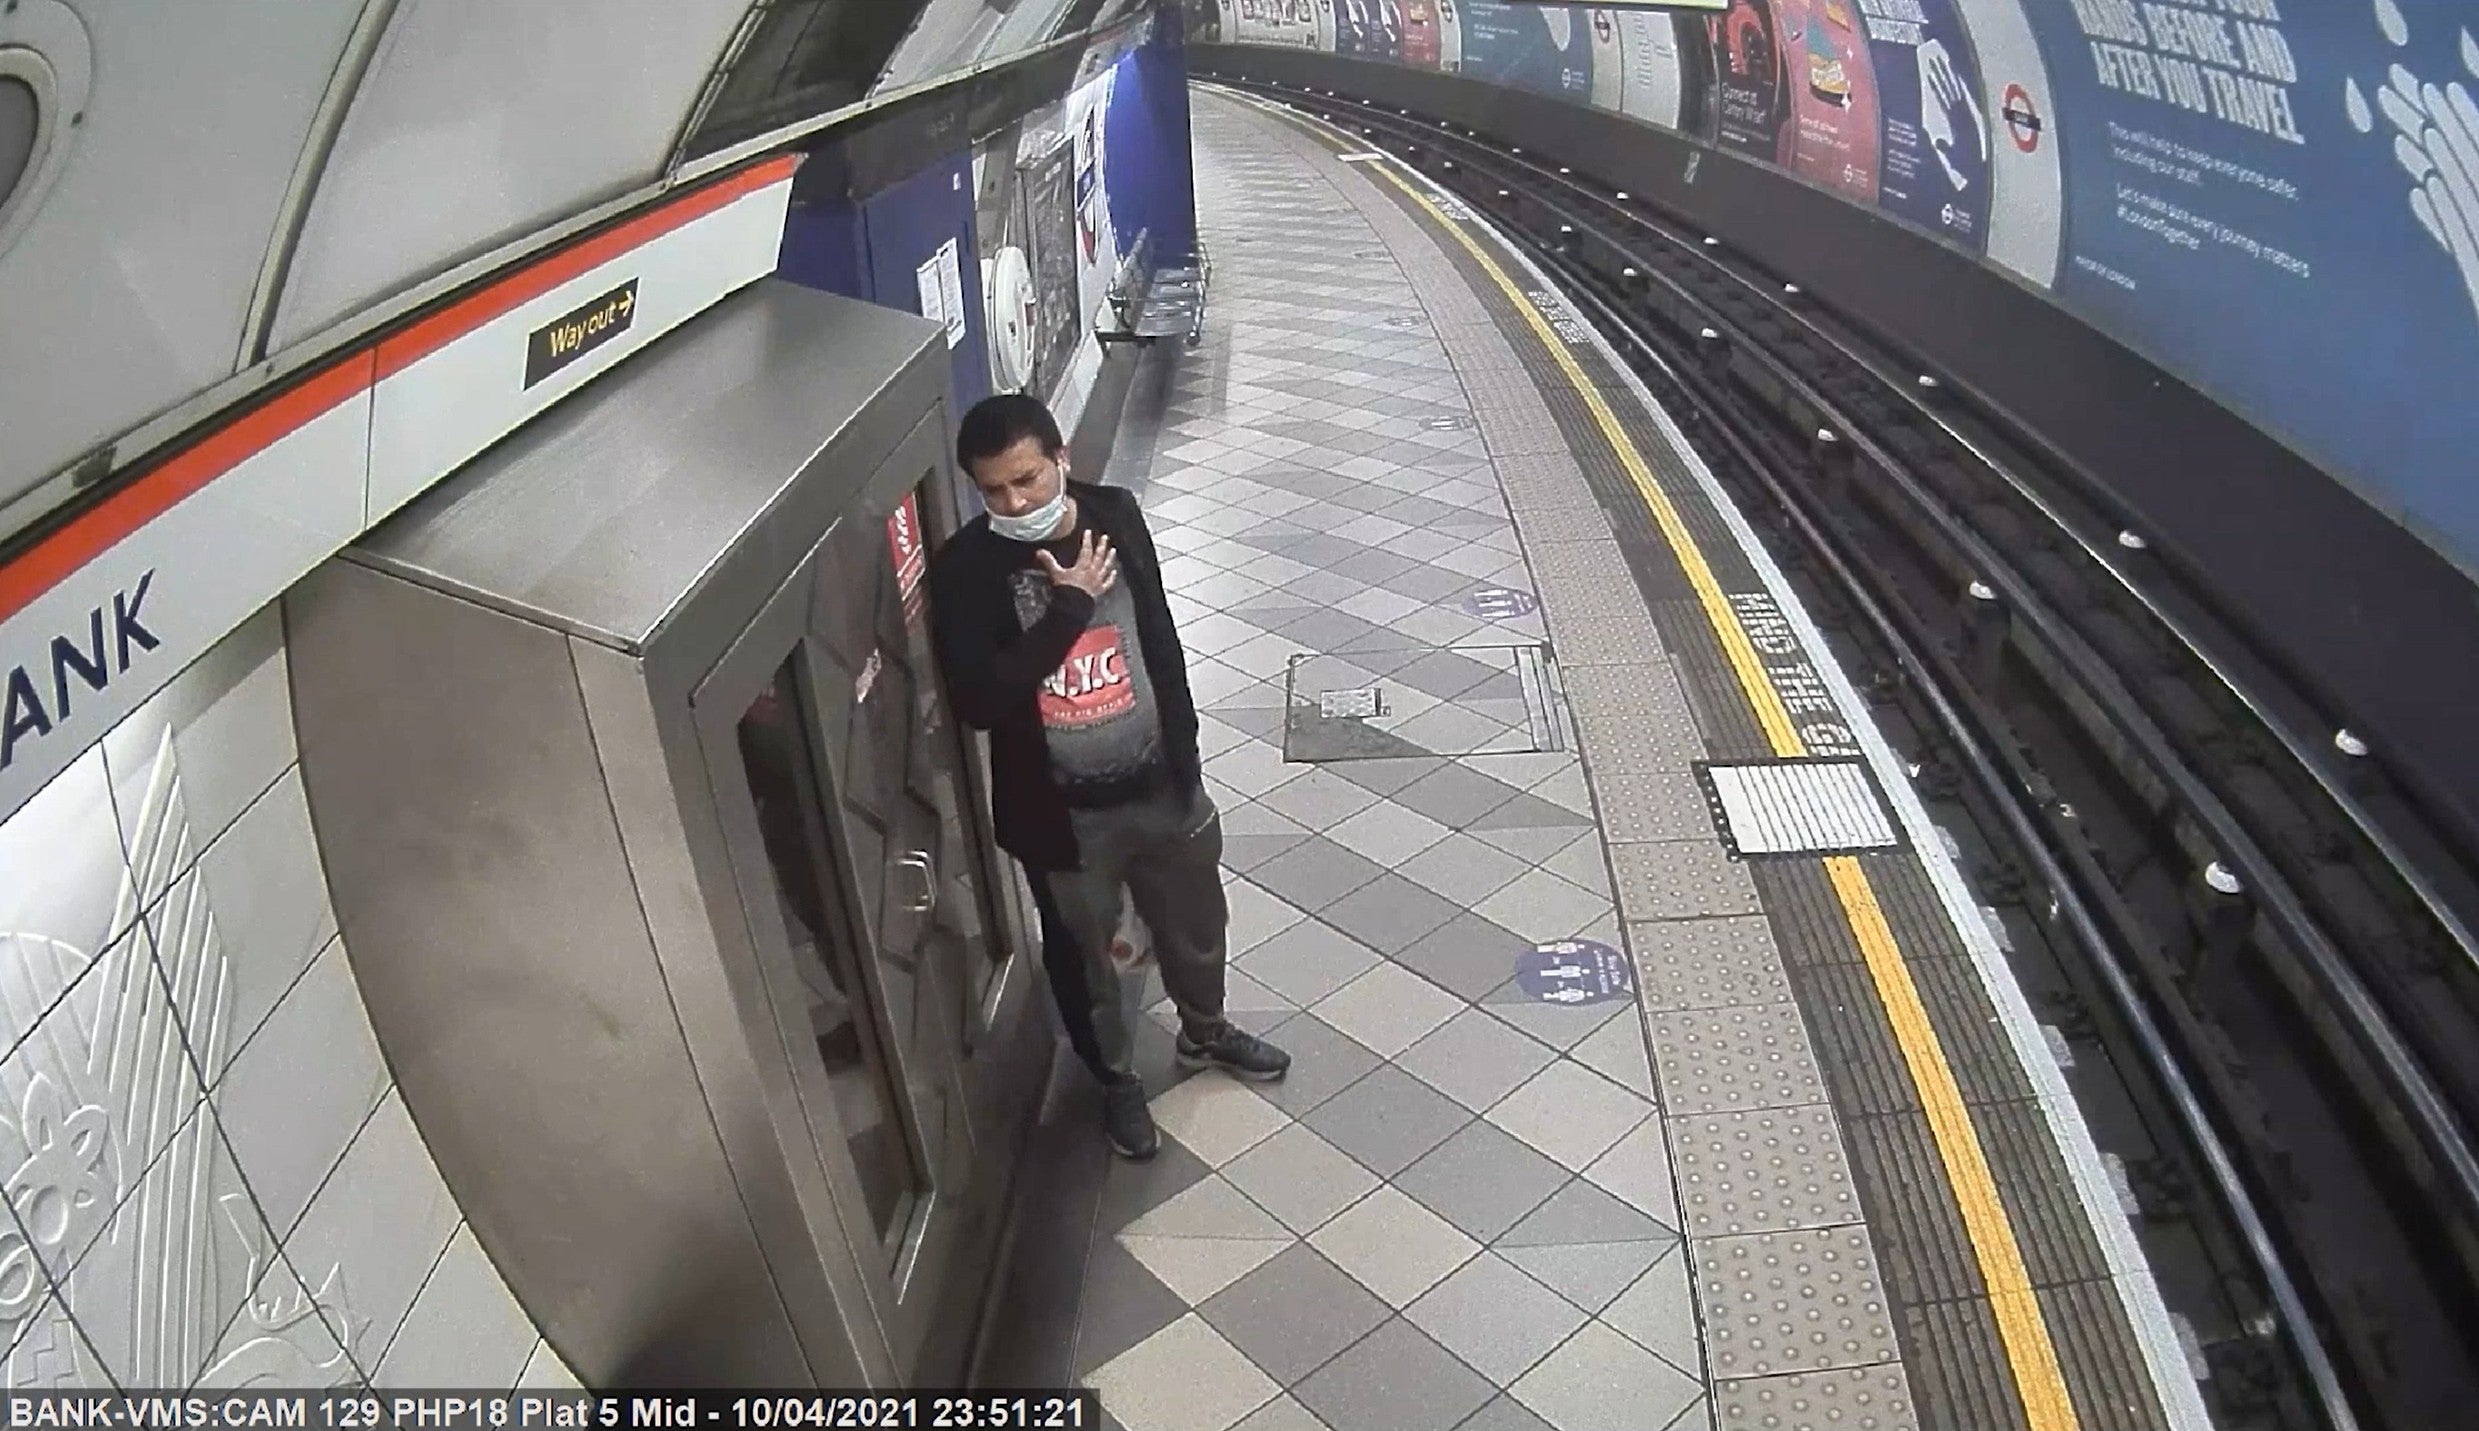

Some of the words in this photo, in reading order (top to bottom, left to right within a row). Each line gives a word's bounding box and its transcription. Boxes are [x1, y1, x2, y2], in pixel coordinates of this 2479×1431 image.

[2090, 41, 2161, 100] AFTER
[2153, 53, 2207, 113] YOU
[2203, 66, 2306, 144] TRAVEL
[2143, 2, 2241, 68] BEFORE
[2236, 20, 2297, 83] AND
[550, 320, 587, 357] Way
[588, 301, 616, 334] out
[0, 567, 161, 770] ANK
[1728, 593, 1797, 654] MIND
[1768, 662, 1832, 715] THE
